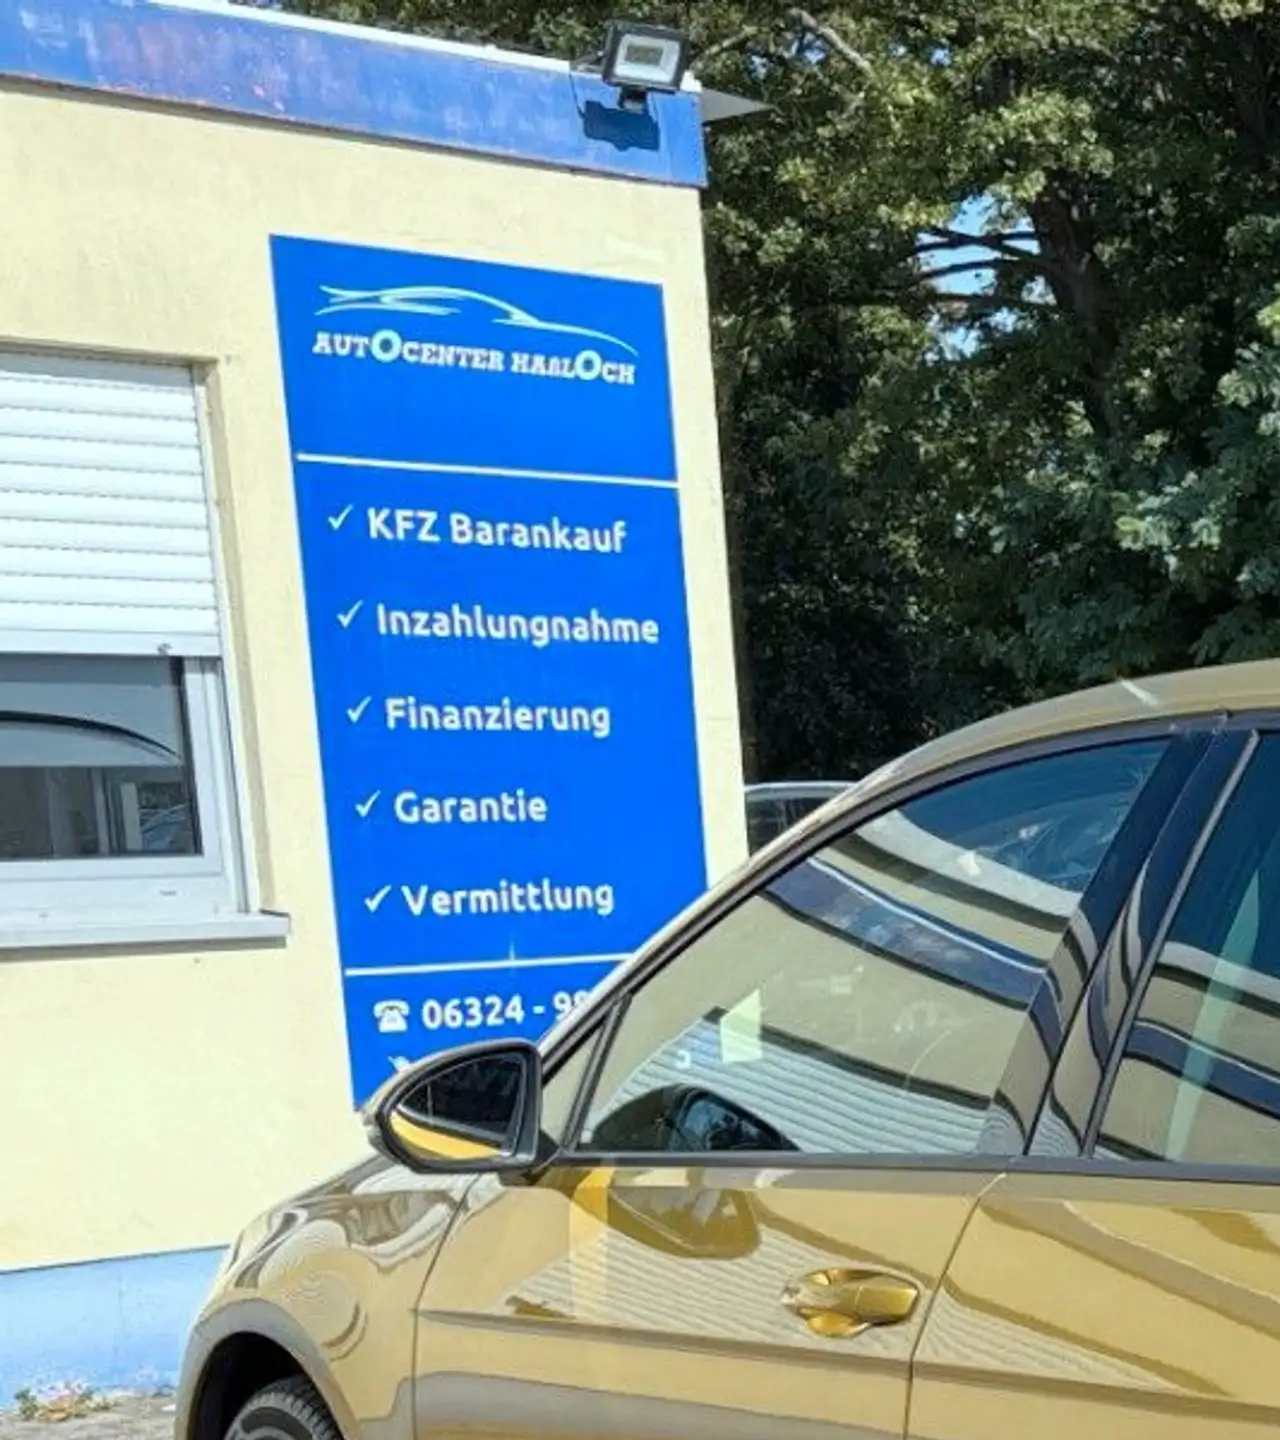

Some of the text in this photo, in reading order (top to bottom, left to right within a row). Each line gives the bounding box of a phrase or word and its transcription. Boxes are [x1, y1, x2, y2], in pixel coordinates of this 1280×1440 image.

[312, 328, 505, 373] AUTOCENTER
[367, 506, 627, 553] KFZ Barankauf
[376, 602, 660, 648] Inzahlungnahme
[385, 696, 611, 739] Finanzierung
[394, 788, 548, 824] Garantie
[401, 877, 615, 915] Vermittlung
[422, 993, 525, 1030] 06324
